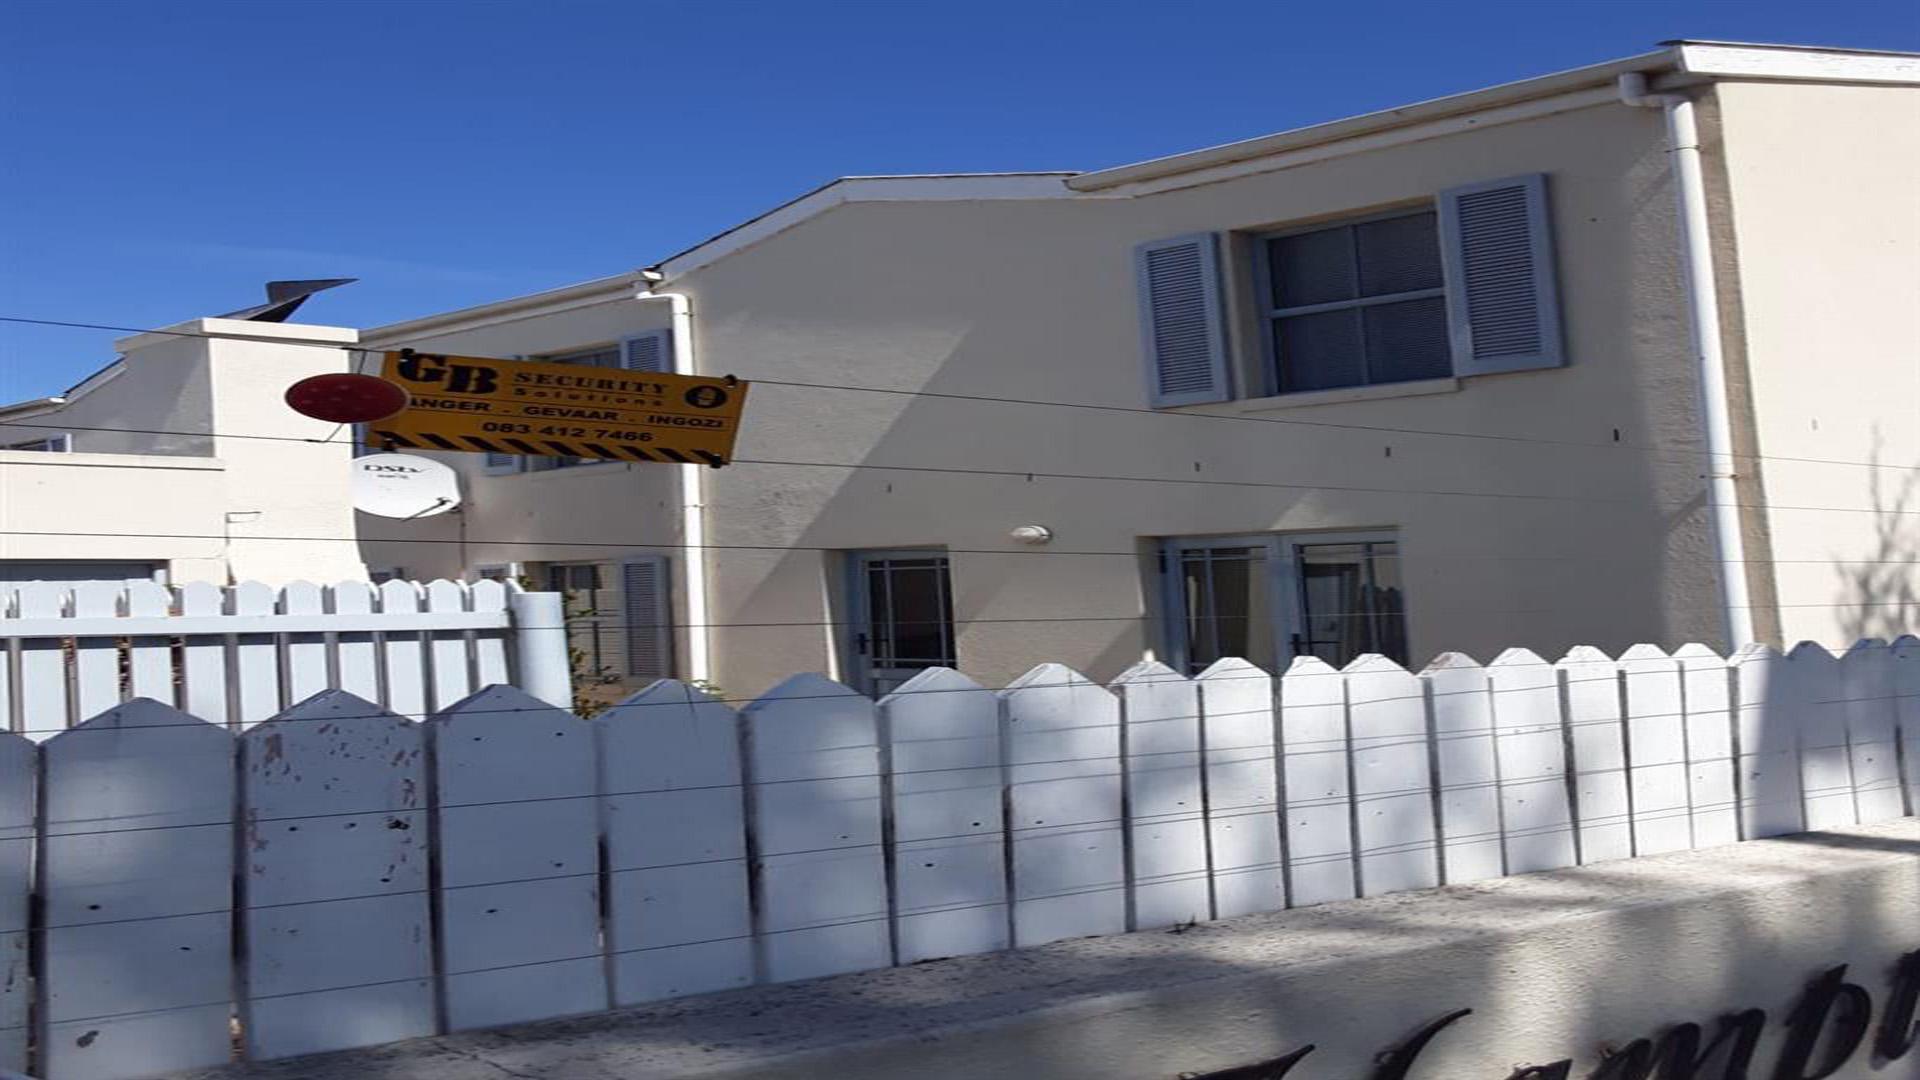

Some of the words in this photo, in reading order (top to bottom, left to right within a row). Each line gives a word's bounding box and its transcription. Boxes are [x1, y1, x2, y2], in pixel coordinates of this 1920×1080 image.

[397, 353, 499, 394] GB
[514, 372, 667, 394] SECURITY
[513, 387, 664, 407] Solutions
[409, 397, 492, 411] NGER
[523, 406, 619, 421] GEVAAR
[647, 415, 723, 428] INGOZI
[482, 421, 531, 434] 083
[539, 424, 586, 438] 412
[594, 428, 654, 442] 7466
